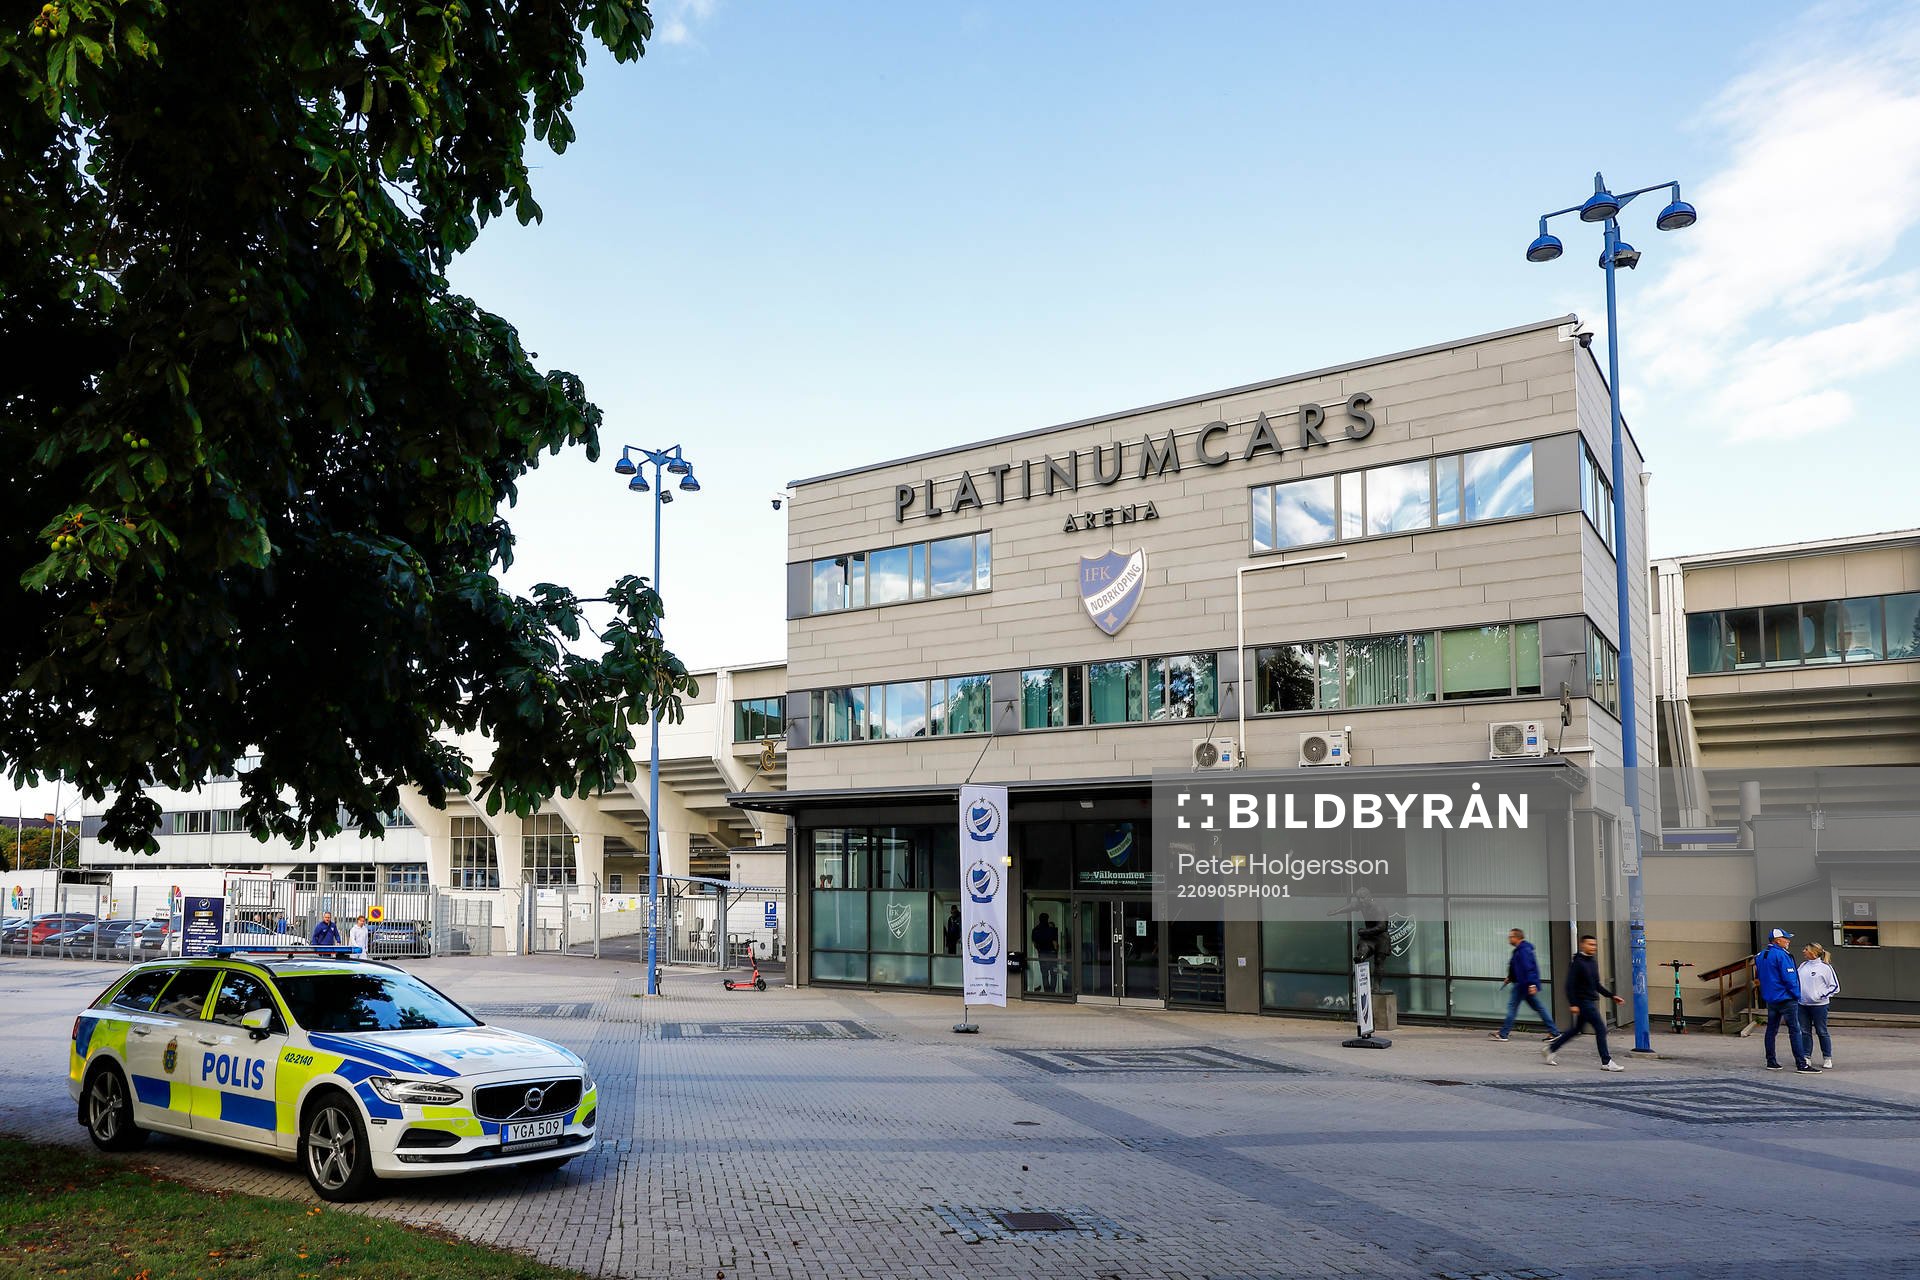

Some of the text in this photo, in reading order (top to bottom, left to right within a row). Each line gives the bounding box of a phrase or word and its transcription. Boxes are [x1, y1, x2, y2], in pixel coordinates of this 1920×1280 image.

[895, 391, 1376, 523] PLATINUMCARS
[1062, 499, 1160, 532] ARENA
[1084, 565, 1112, 582] IFK
[1089, 562, 1142, 612] NORRKÖPING
[1093, 870, 1145, 879] Välkommen
[767, 902, 775, 914] P
[284, 1053, 314, 1066] 42-2140
[202, 1051, 266, 1091] POLIS
[513, 1120, 560, 1140] YGA 509
